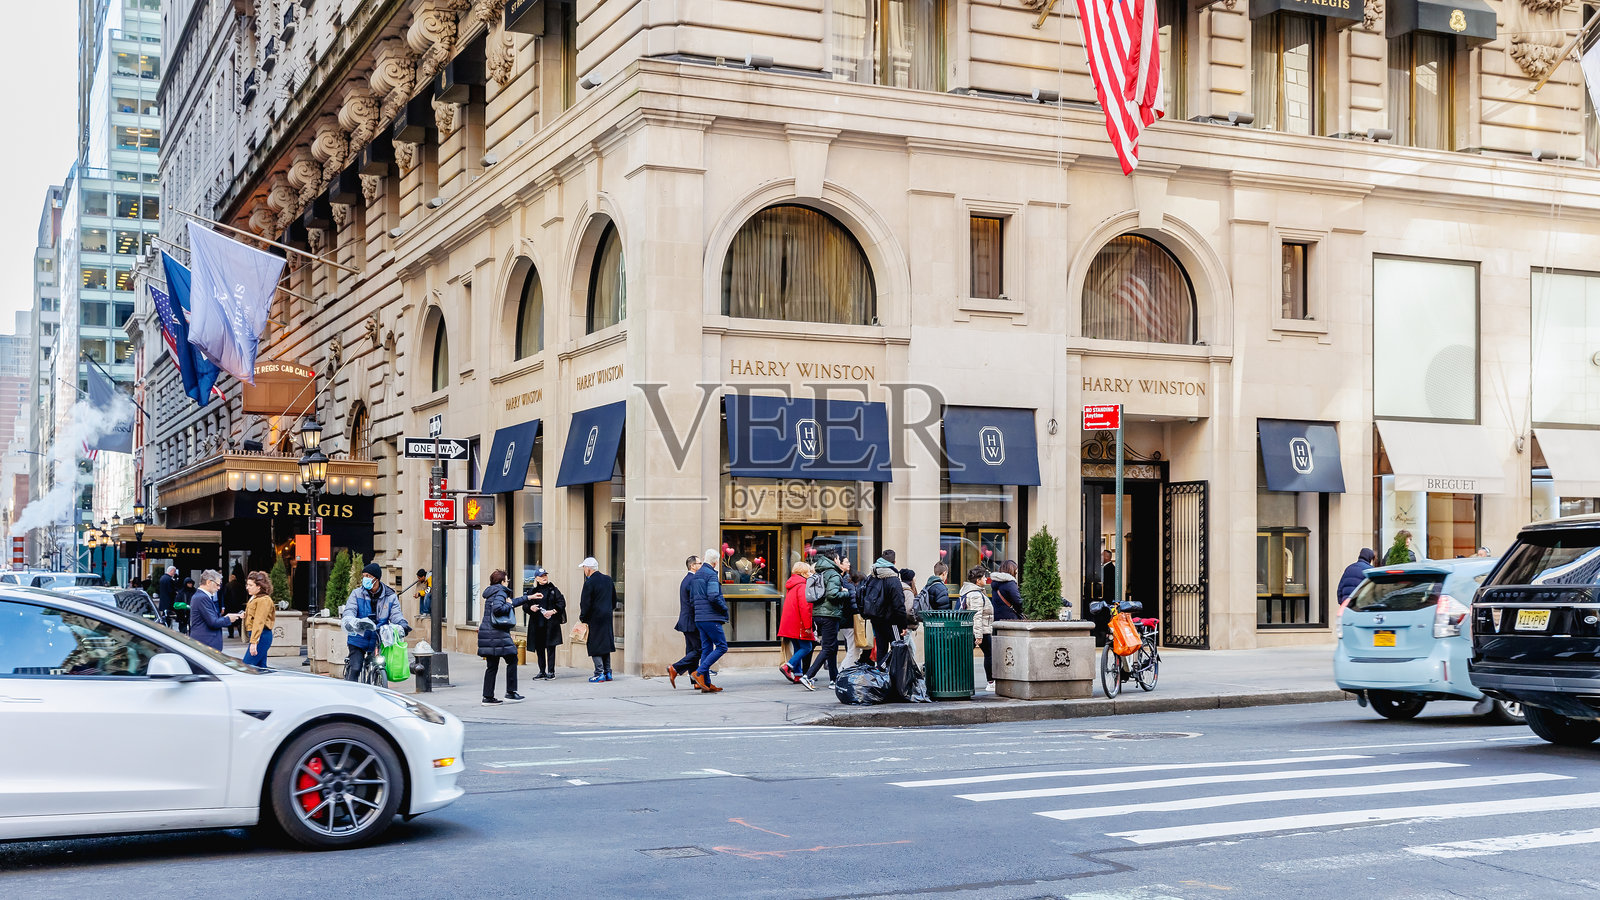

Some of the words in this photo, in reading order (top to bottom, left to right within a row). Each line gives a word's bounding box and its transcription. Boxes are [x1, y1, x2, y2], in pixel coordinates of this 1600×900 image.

[261, 364, 280, 374] REGIS
[281, 365, 294, 374] CAB
[294, 367, 309, 378] CALL
[576, 372, 595, 391] HARRY
[597, 363, 624, 385] WINSTON
[730, 359, 790, 377] HARRY
[796, 362, 876, 381] WINSTON
[1082, 376, 1134, 394] HARRY
[1138, 379, 1206, 397] WINSTON
[505, 394, 520, 412] HARRY
[520, 388, 543, 406] WINSTON
[413, 444, 432, 453] ONE
[440, 445, 459, 454] WAY
[1427, 478, 1476, 491] BREGUET
[287, 502, 353, 518] REGIS
